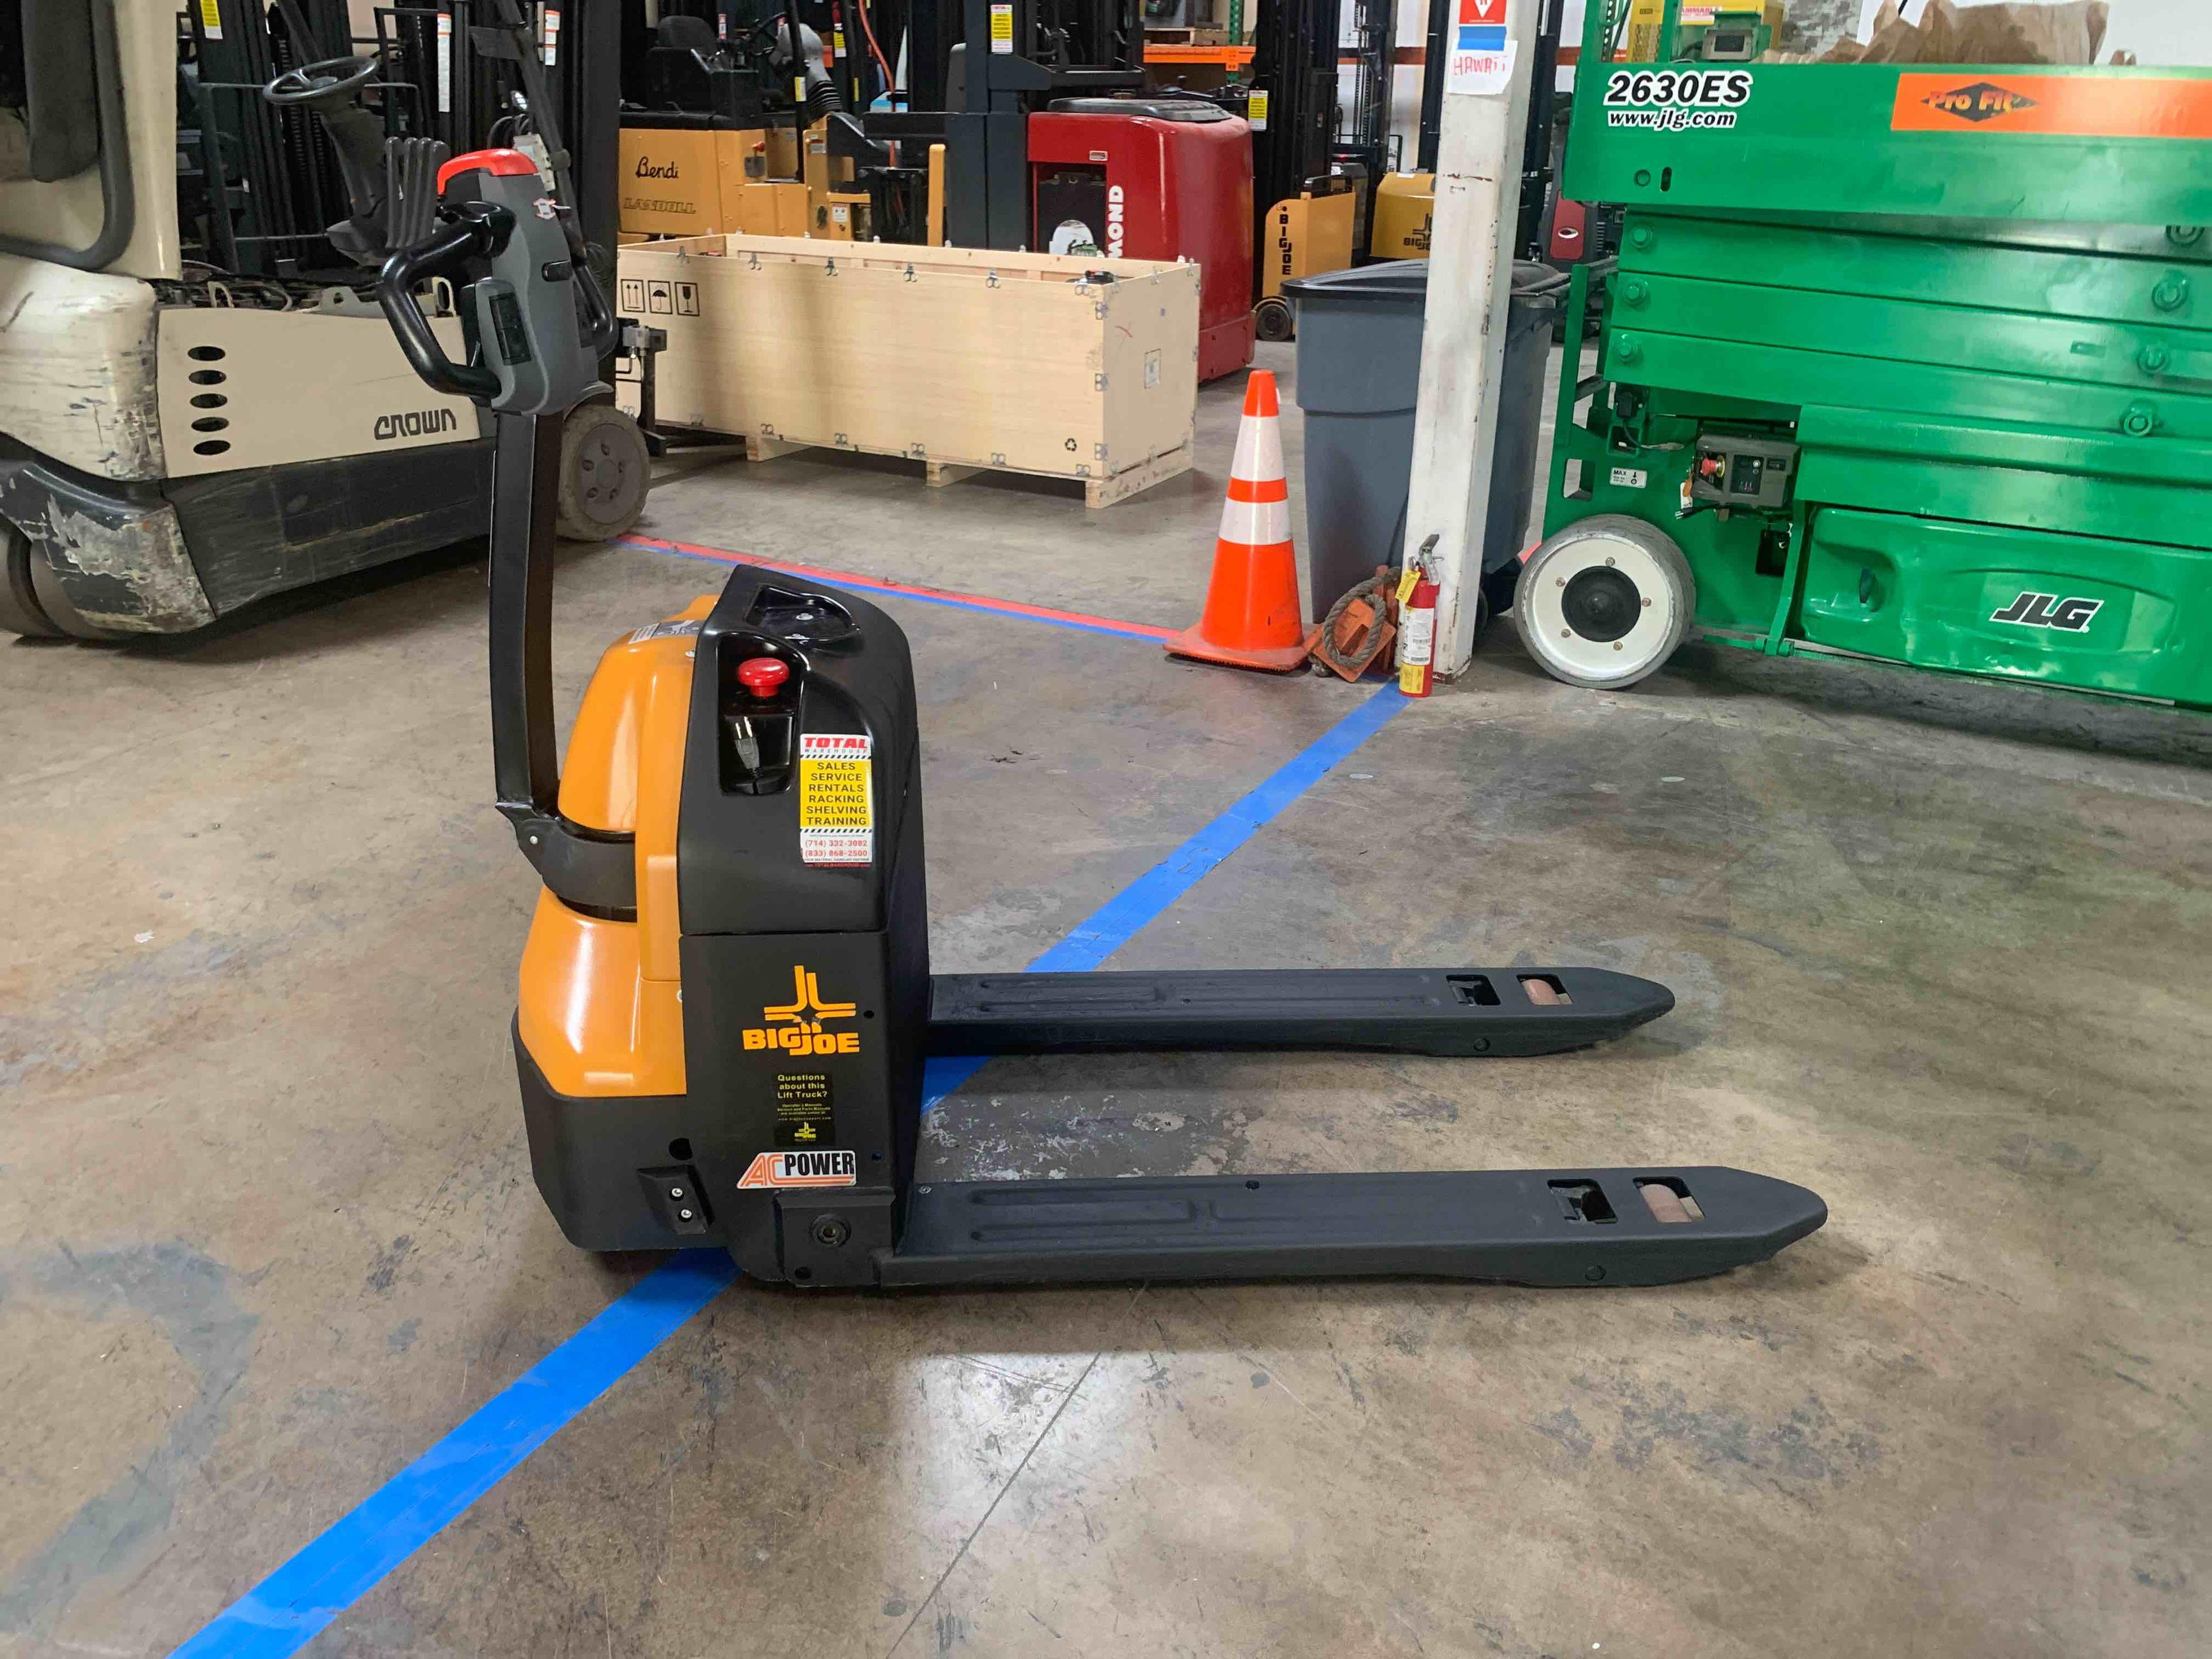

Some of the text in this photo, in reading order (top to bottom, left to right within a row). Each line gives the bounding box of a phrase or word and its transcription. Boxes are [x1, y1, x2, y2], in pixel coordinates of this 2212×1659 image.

[1607, 74, 1750, 103] 2630ES
[1929, 91, 1972, 111] Pro
[1609, 109, 1735, 129] www.jlg.com
[635, 156, 679, 179] Bendi
[1107, 185, 1124, 258] MOND
[1403, 237, 1431, 251] BIGJO
[374, 408, 457, 440] CROWN
[1991, 592, 2103, 631] JLG
[804, 737, 868, 748] TOTAL
[817, 762, 855, 771] SALES
[810, 772, 862, 781] SERVICE
[808, 783, 864, 793] RENTALS
[809, 794, 864, 803] RACKING
[806, 806, 867, 815] SHELVING
[806, 817, 866, 825] TRAINING
[805, 839, 827, 847] (714)
[805, 849, 827, 858] (833)
[784, 1153, 855, 1176] POWER
